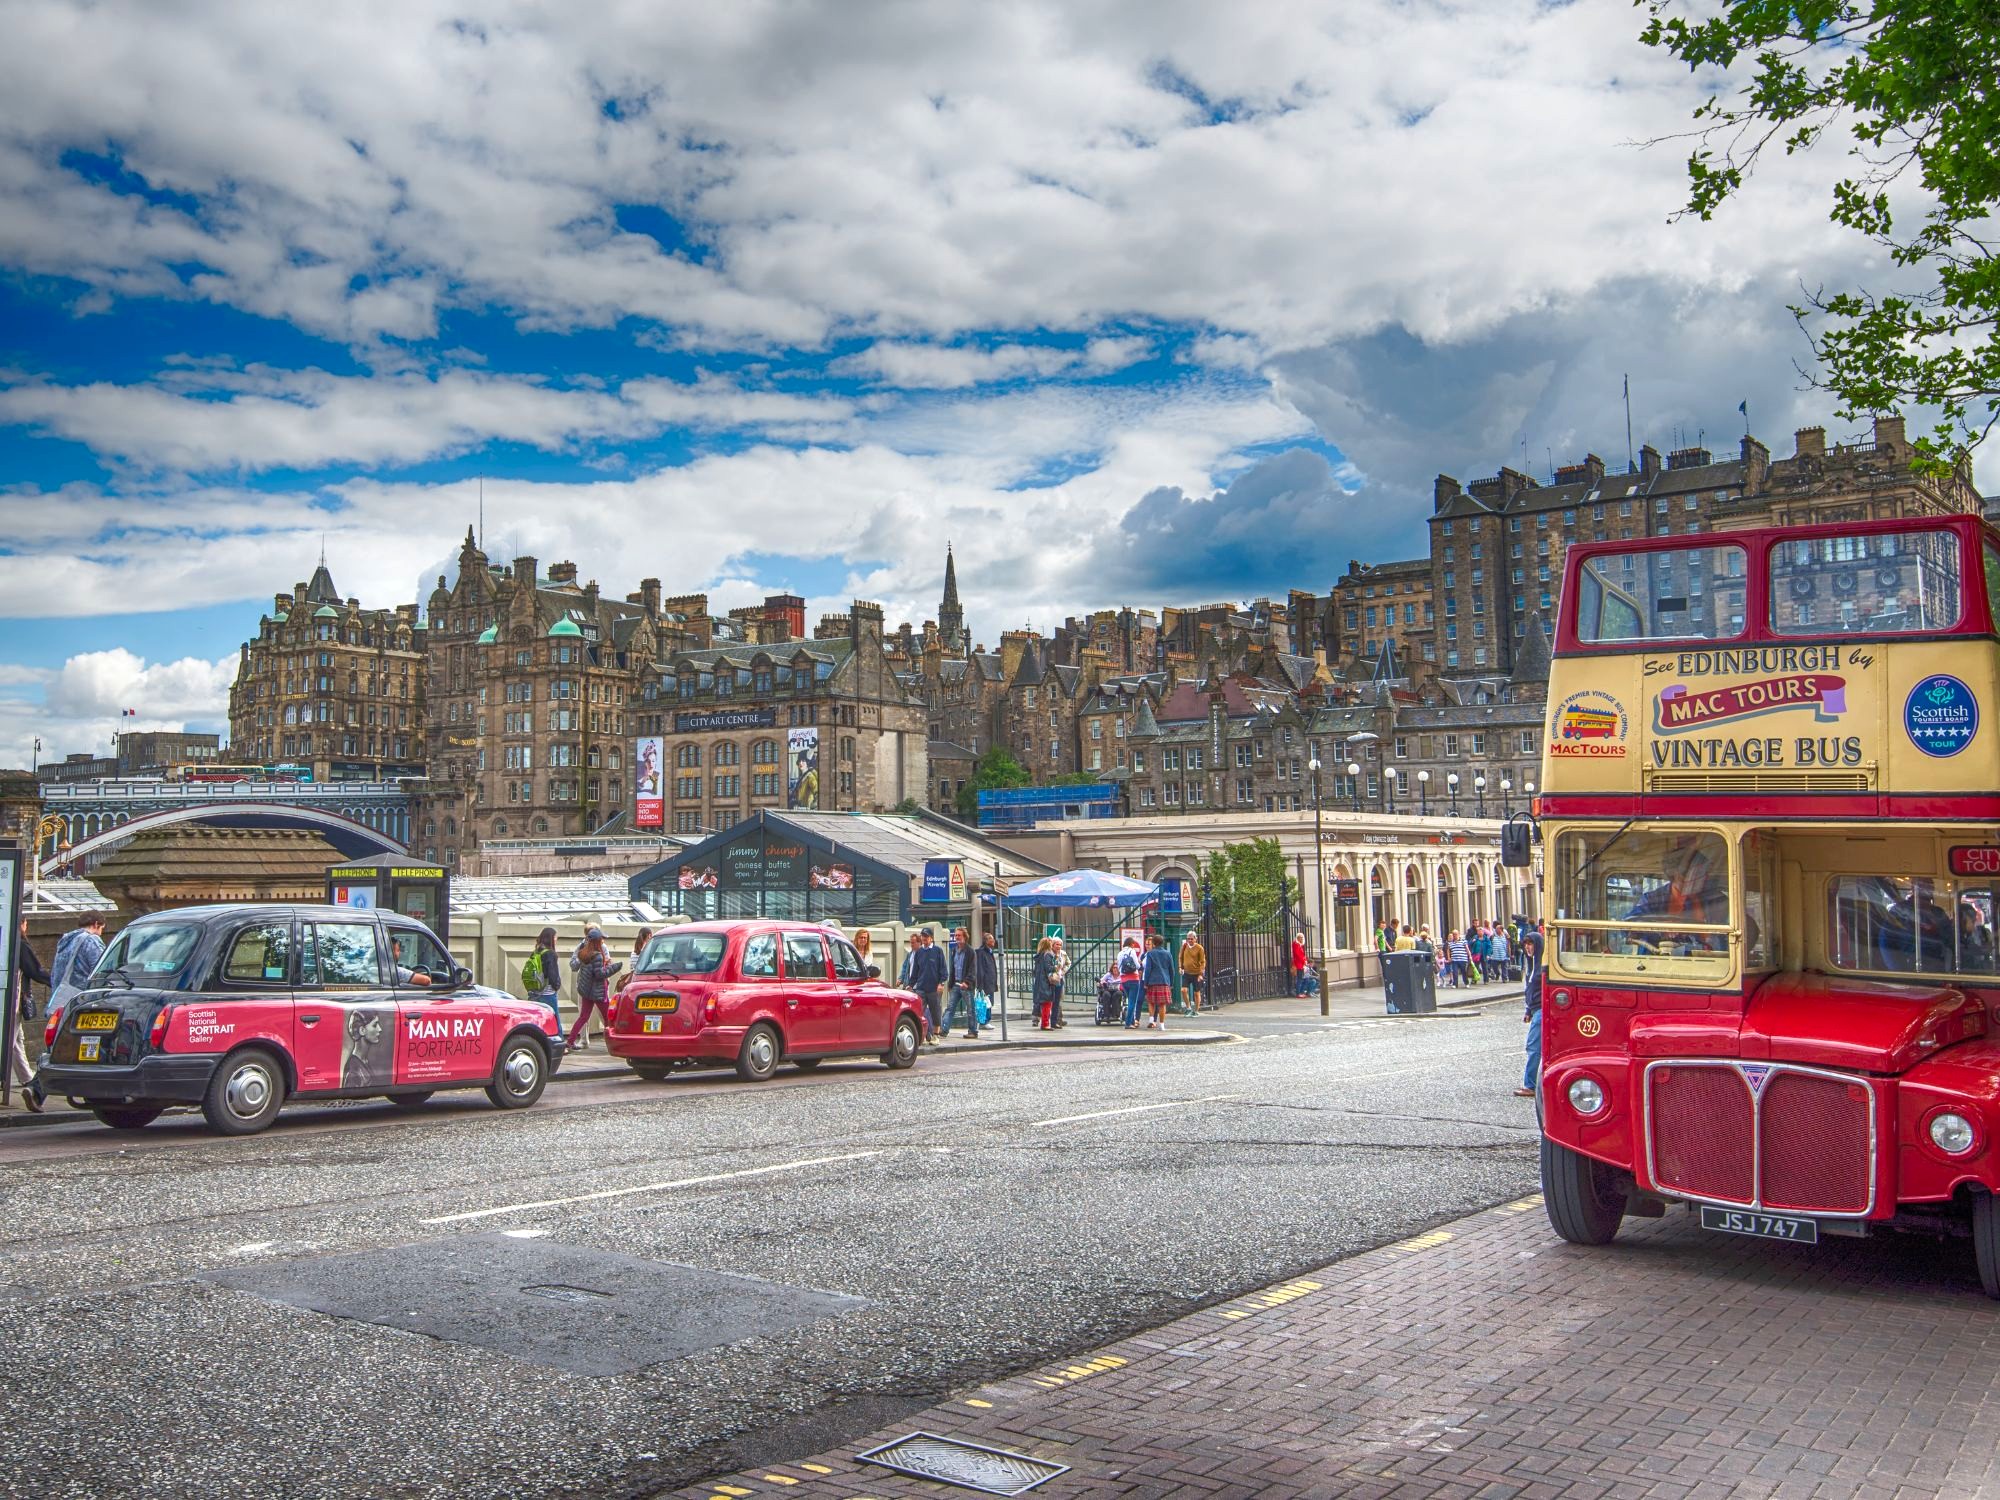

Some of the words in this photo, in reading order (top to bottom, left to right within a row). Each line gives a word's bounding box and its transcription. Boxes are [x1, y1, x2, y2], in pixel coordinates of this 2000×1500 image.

[1644, 660, 1675, 676] See
[1677, 646, 1840, 676] EDINBURGH
[1849, 648, 1875, 669] by
[1671, 694, 1725, 722] MAC
[1731, 678, 1817, 708] TOURS
[1552, 703, 1566, 739] EDINBURGH'S
[1565, 691, 1590, 704] PREMIER
[1592, 690, 1616, 704] VINTAGE
[1615, 702, 1625, 714] BUS
[1620, 713, 1628, 742] COMPANY
[1912, 704, 1969, 718] Scottish
[690, 717, 710, 727] CITY
[709, 716, 725, 725] ART
[726, 714, 759, 725] CENTRE
[1651, 738, 1784, 768] VINTAGE
[1795, 736, 1862, 766] BUS
[726, 846, 760, 860] jimmy
[765, 844, 805, 858] chung's
[734, 860, 763, 869] chinese
[768, 860, 791, 869] buffet
[1962, 860, 2000, 871] TOU
[336, 868, 373, 877] TELEPHONE
[396, 868, 439, 877] TELEPHONE
[734, 871, 750, 879] open
[764, 869, 779, 878] days
[188, 1010, 217, 1018] Scottish
[188, 1017, 217, 1026] National
[1582, 1019, 1597, 1033] 292
[189, 1024, 236, 1036] PORTRAIT
[408, 1019, 449, 1040] MAN
[453, 1018, 484, 1038] RAY
[189, 1035, 214, 1044] Gallery
[407, 1039, 483, 1058] PORTRAITS
[1719, 1212, 1756, 1233] JSJ
[1760, 1217, 1799, 1238] 747
